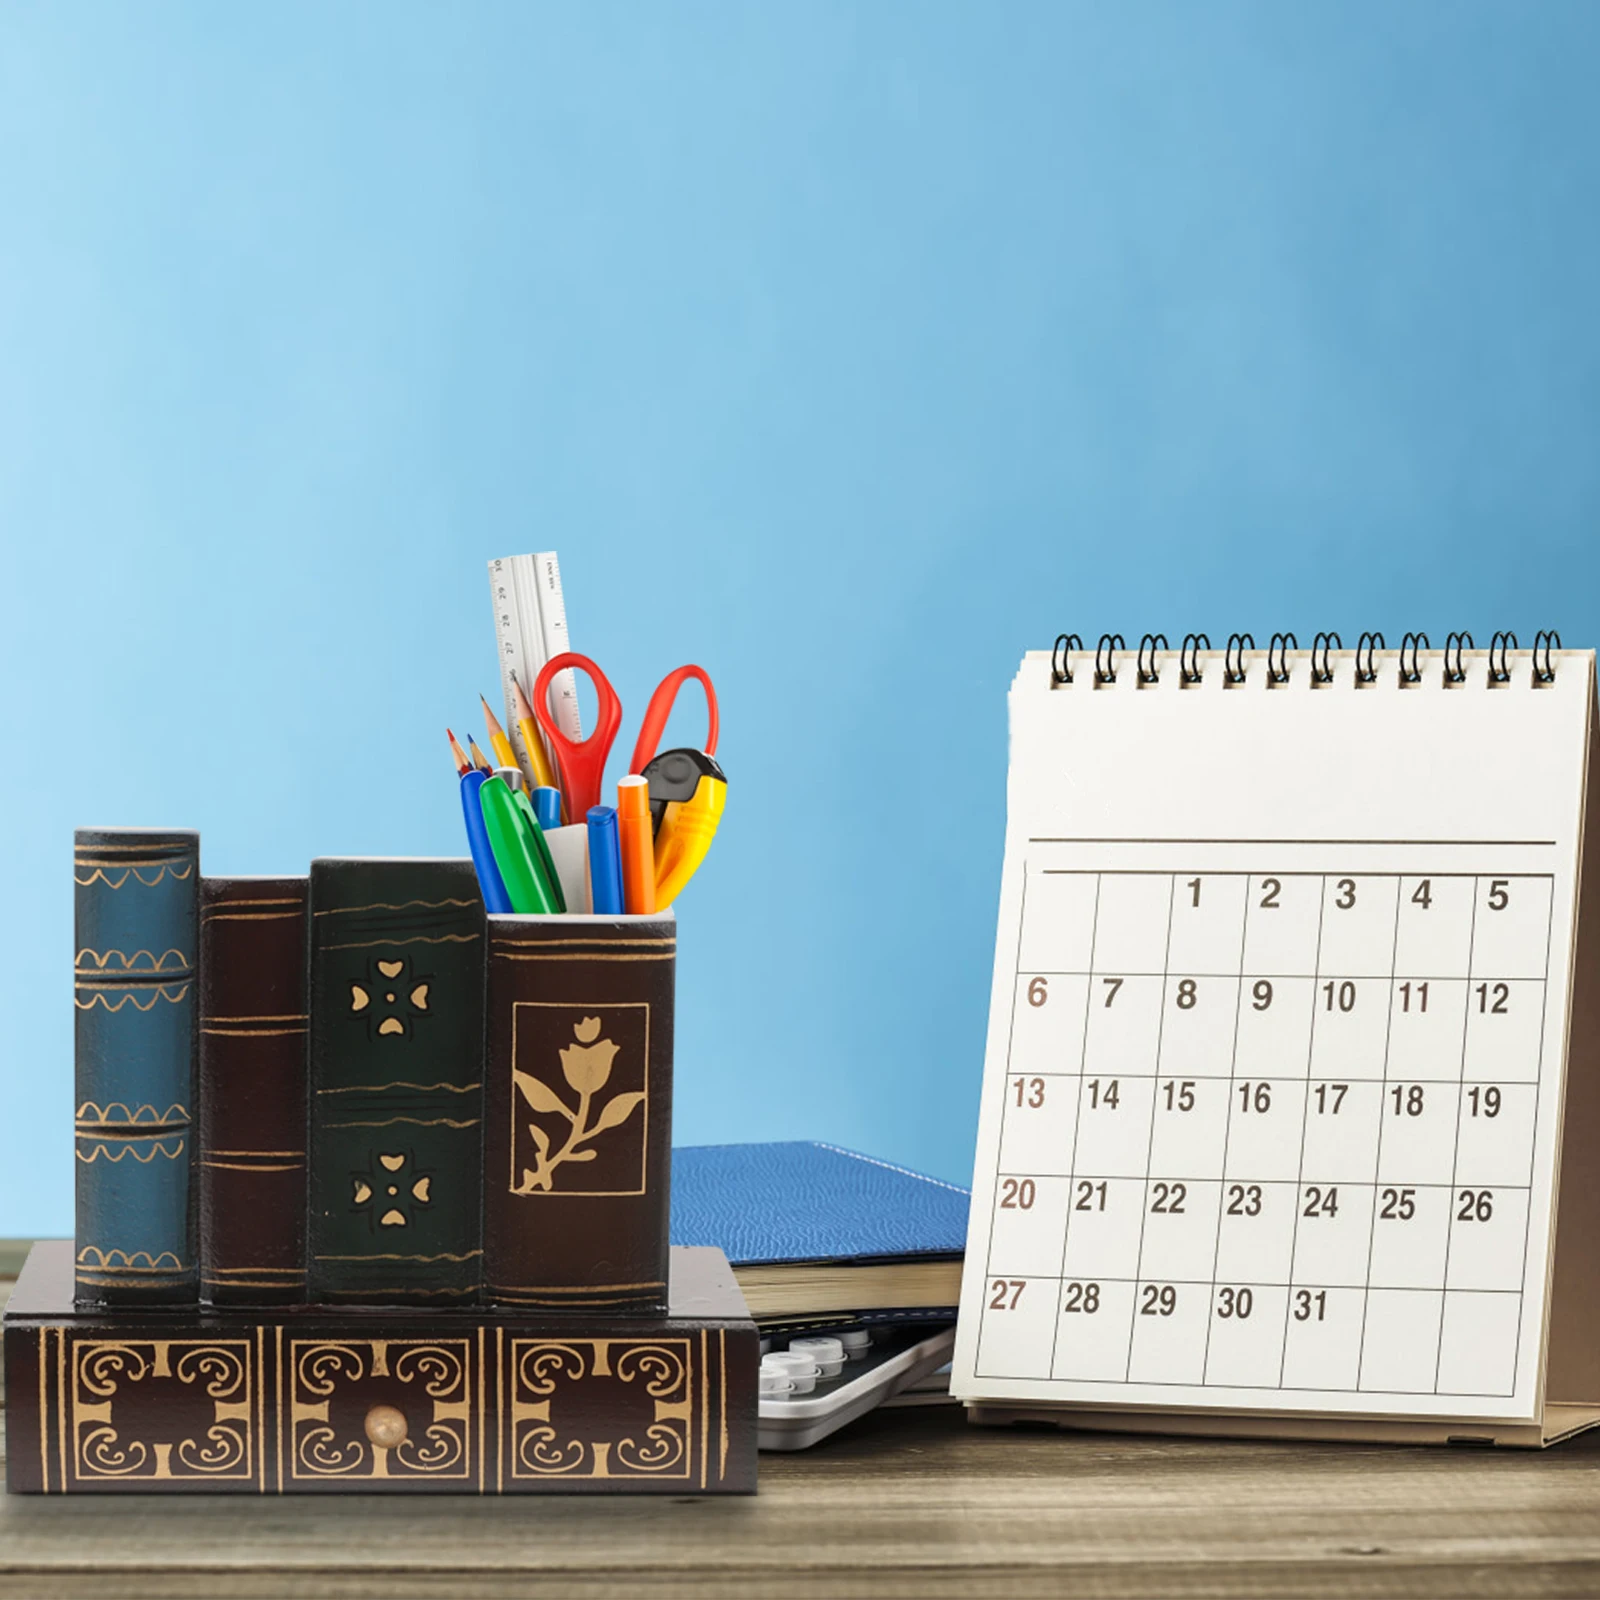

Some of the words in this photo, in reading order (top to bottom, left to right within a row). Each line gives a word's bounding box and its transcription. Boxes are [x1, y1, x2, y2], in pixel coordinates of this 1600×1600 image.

[498, 586, 506, 600] 29
[502, 614, 510, 627] 28
[505, 642, 514, 654] 27
[1188, 878, 1201, 907] 1
[1260, 878, 1281, 908] 2
[1336, 879, 1356, 909] 3
[1412, 880, 1432, 909] 4
[1488, 880, 1508, 910] 5
[1028, 977, 1047, 1007] 6
[1103, 978, 1123, 1007] 7
[1177, 979, 1196, 1009] 8
[1253, 980, 1273, 1011] 9
[1323, 981, 1356, 1012] 10
[1399, 982, 1427, 1012] 11
[1476, 983, 1509, 1013] 12
[1014, 1078, 1044, 1108] 13
[1088, 1079, 1119, 1109] 14
[1163, 1081, 1195, 1111] 15
[1239, 1082, 1271, 1113] 16
[1315, 1084, 1348, 1114] 17
[1392, 1085, 1423, 1116] 18
[1468, 1086, 1501, 1118] 19
[1001, 1179, 1035, 1209] 20
[1076, 1181, 1107, 1211] 21
[1151, 1183, 1186, 1213] 22
[1227, 1185, 1262, 1216] 23
[1303, 1187, 1338, 1218] 24
[1380, 1188, 1415, 1220] 25
[1457, 1190, 1493, 1222] 26
[990, 1280, 1026, 1310] 27
[1065, 1283, 1100, 1314] 28
[1141, 1285, 1176, 1316] 29
[1218, 1287, 1252, 1319] 30
[1294, 1290, 1326, 1321] 31
